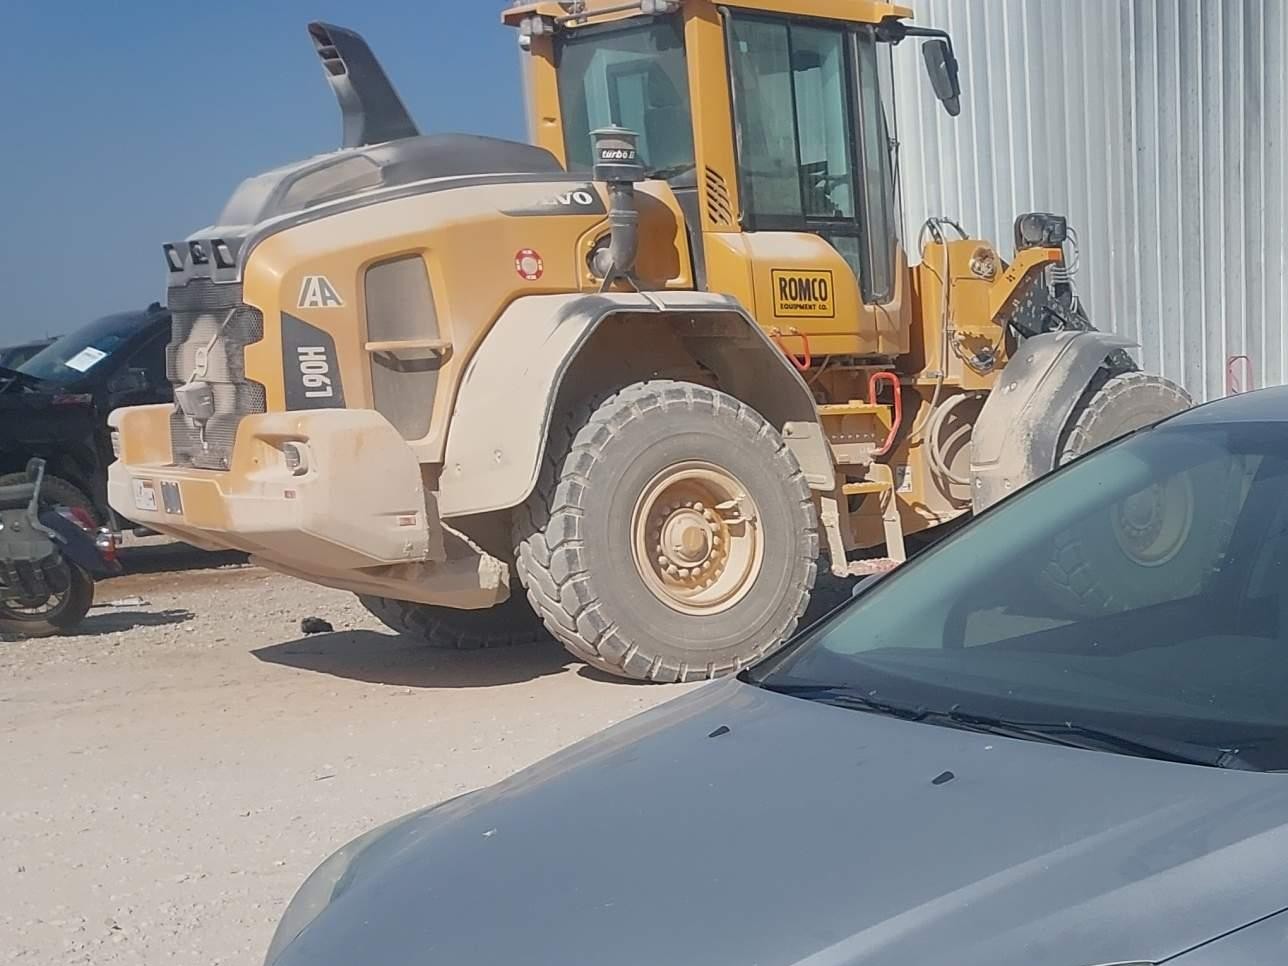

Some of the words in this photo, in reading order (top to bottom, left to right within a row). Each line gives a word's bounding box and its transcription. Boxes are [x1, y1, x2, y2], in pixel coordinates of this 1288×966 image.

[601, 149, 628, 160] turbo
[778, 276, 829, 302] ROMCO
[780, 303, 817, 311] EQUIPMENT
[297, 346, 334, 398] L90H
